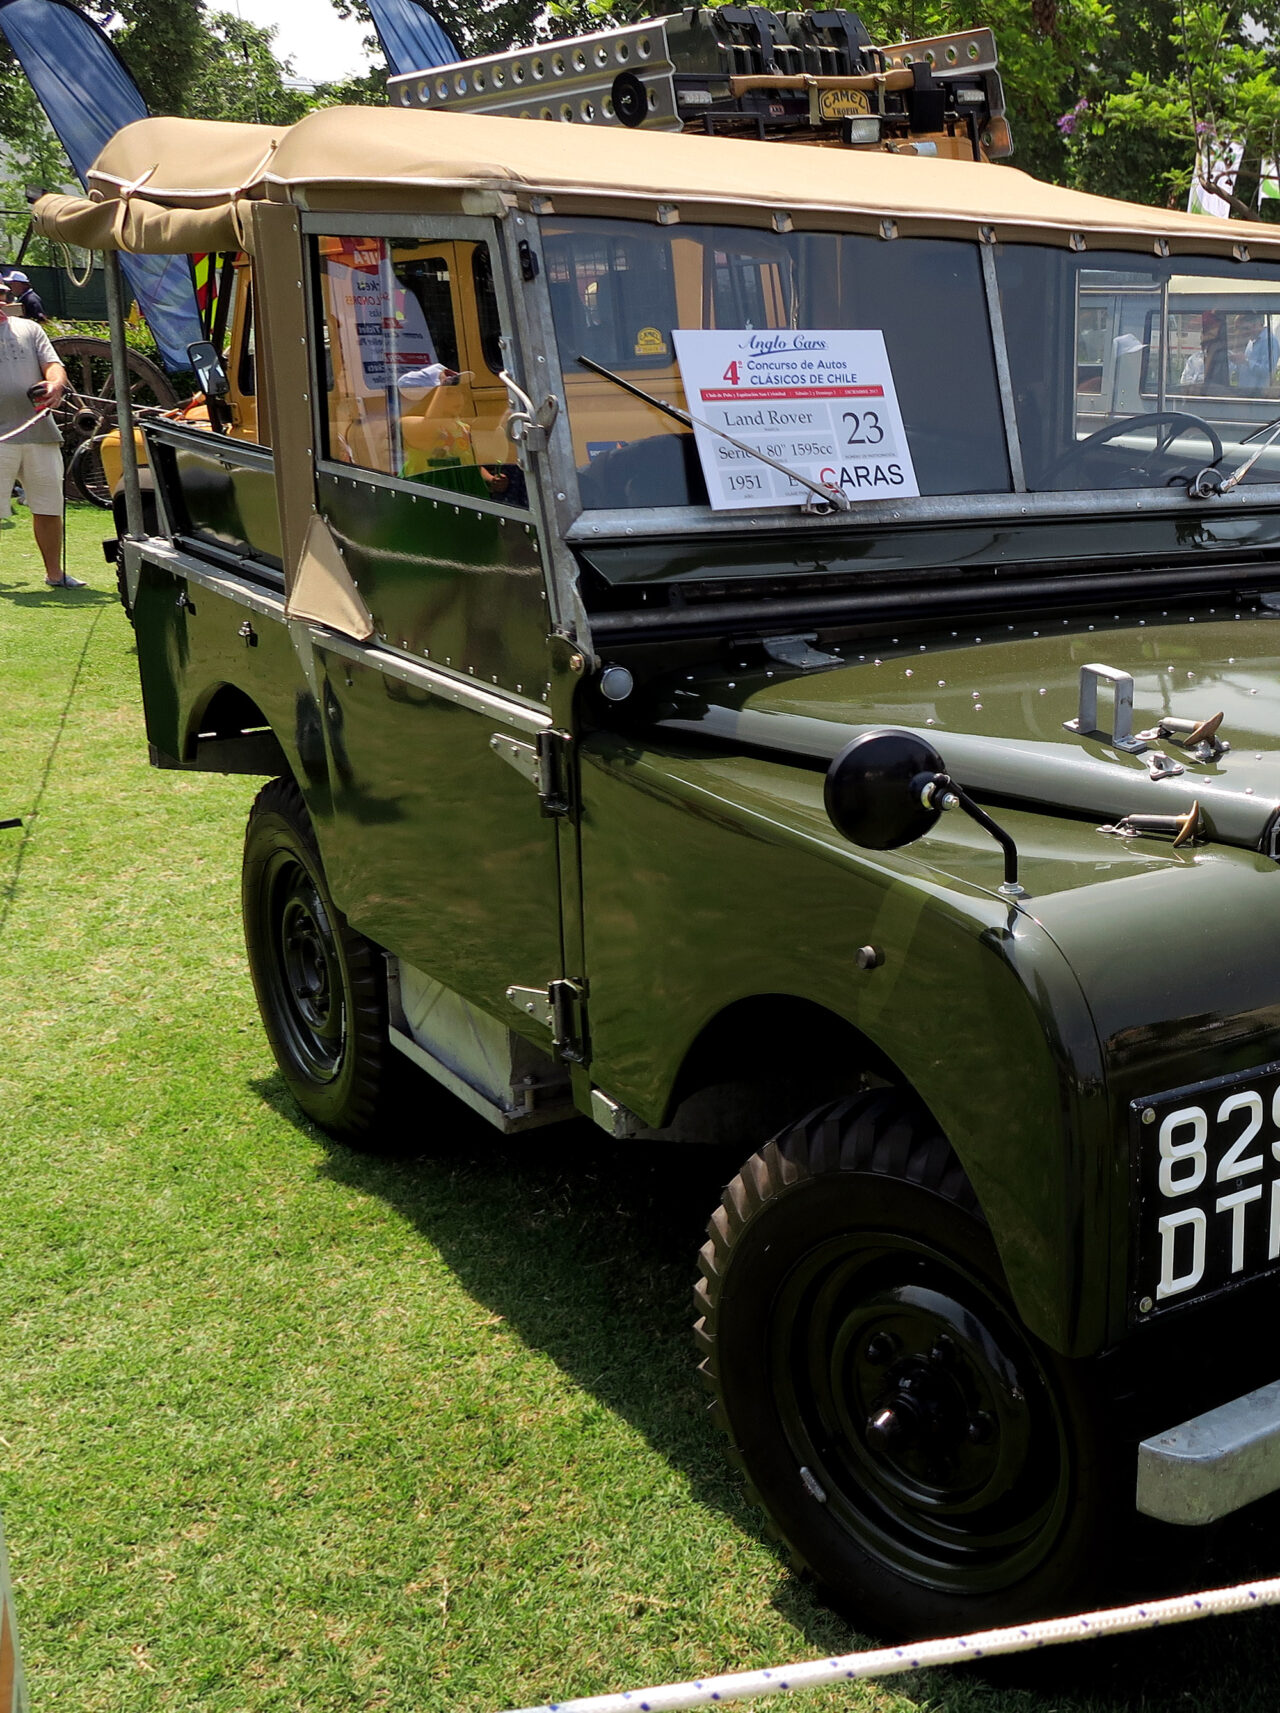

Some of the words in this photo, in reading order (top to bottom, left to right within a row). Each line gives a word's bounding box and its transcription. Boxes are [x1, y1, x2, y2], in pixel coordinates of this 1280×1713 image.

[823, 90, 866, 109] CAMEL
[739, 335, 787, 354] Anglo
[793, 335, 829, 350] Cars
[747, 360, 798, 370] Concurso
[800, 360, 814, 370] de
[817, 360, 848, 370] Autos
[750, 372, 806, 385] CLÁSICOS
[809, 374, 824, 384] DE
[827, 373, 857, 384] CHILE
[723, 410, 765, 427] Land
[767, 409, 814, 426] Rover
[842, 411, 884, 445] 23
[791, 443, 832, 457] 1595cc
[728, 475, 762, 490] 1951
[820, 464, 905, 494] CARAS
